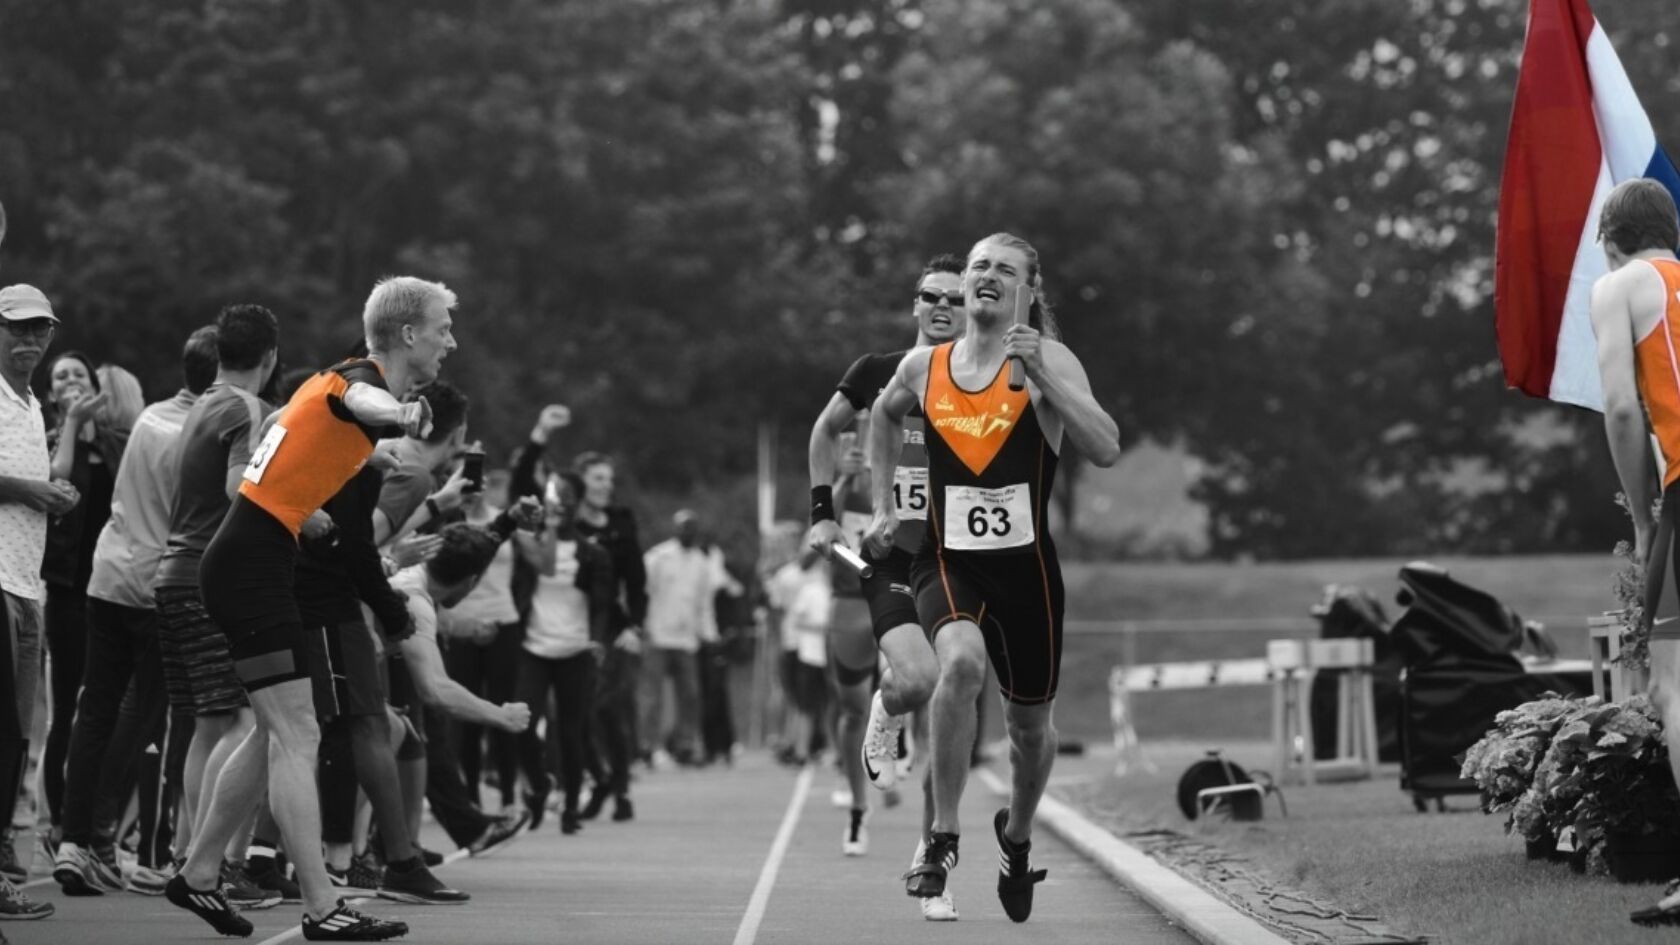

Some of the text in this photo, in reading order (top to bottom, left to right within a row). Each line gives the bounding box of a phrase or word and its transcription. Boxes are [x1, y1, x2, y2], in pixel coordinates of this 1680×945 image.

[250, 442, 271, 469] 3
[893, 483, 927, 511] 15
[967, 506, 1011, 537] 63
